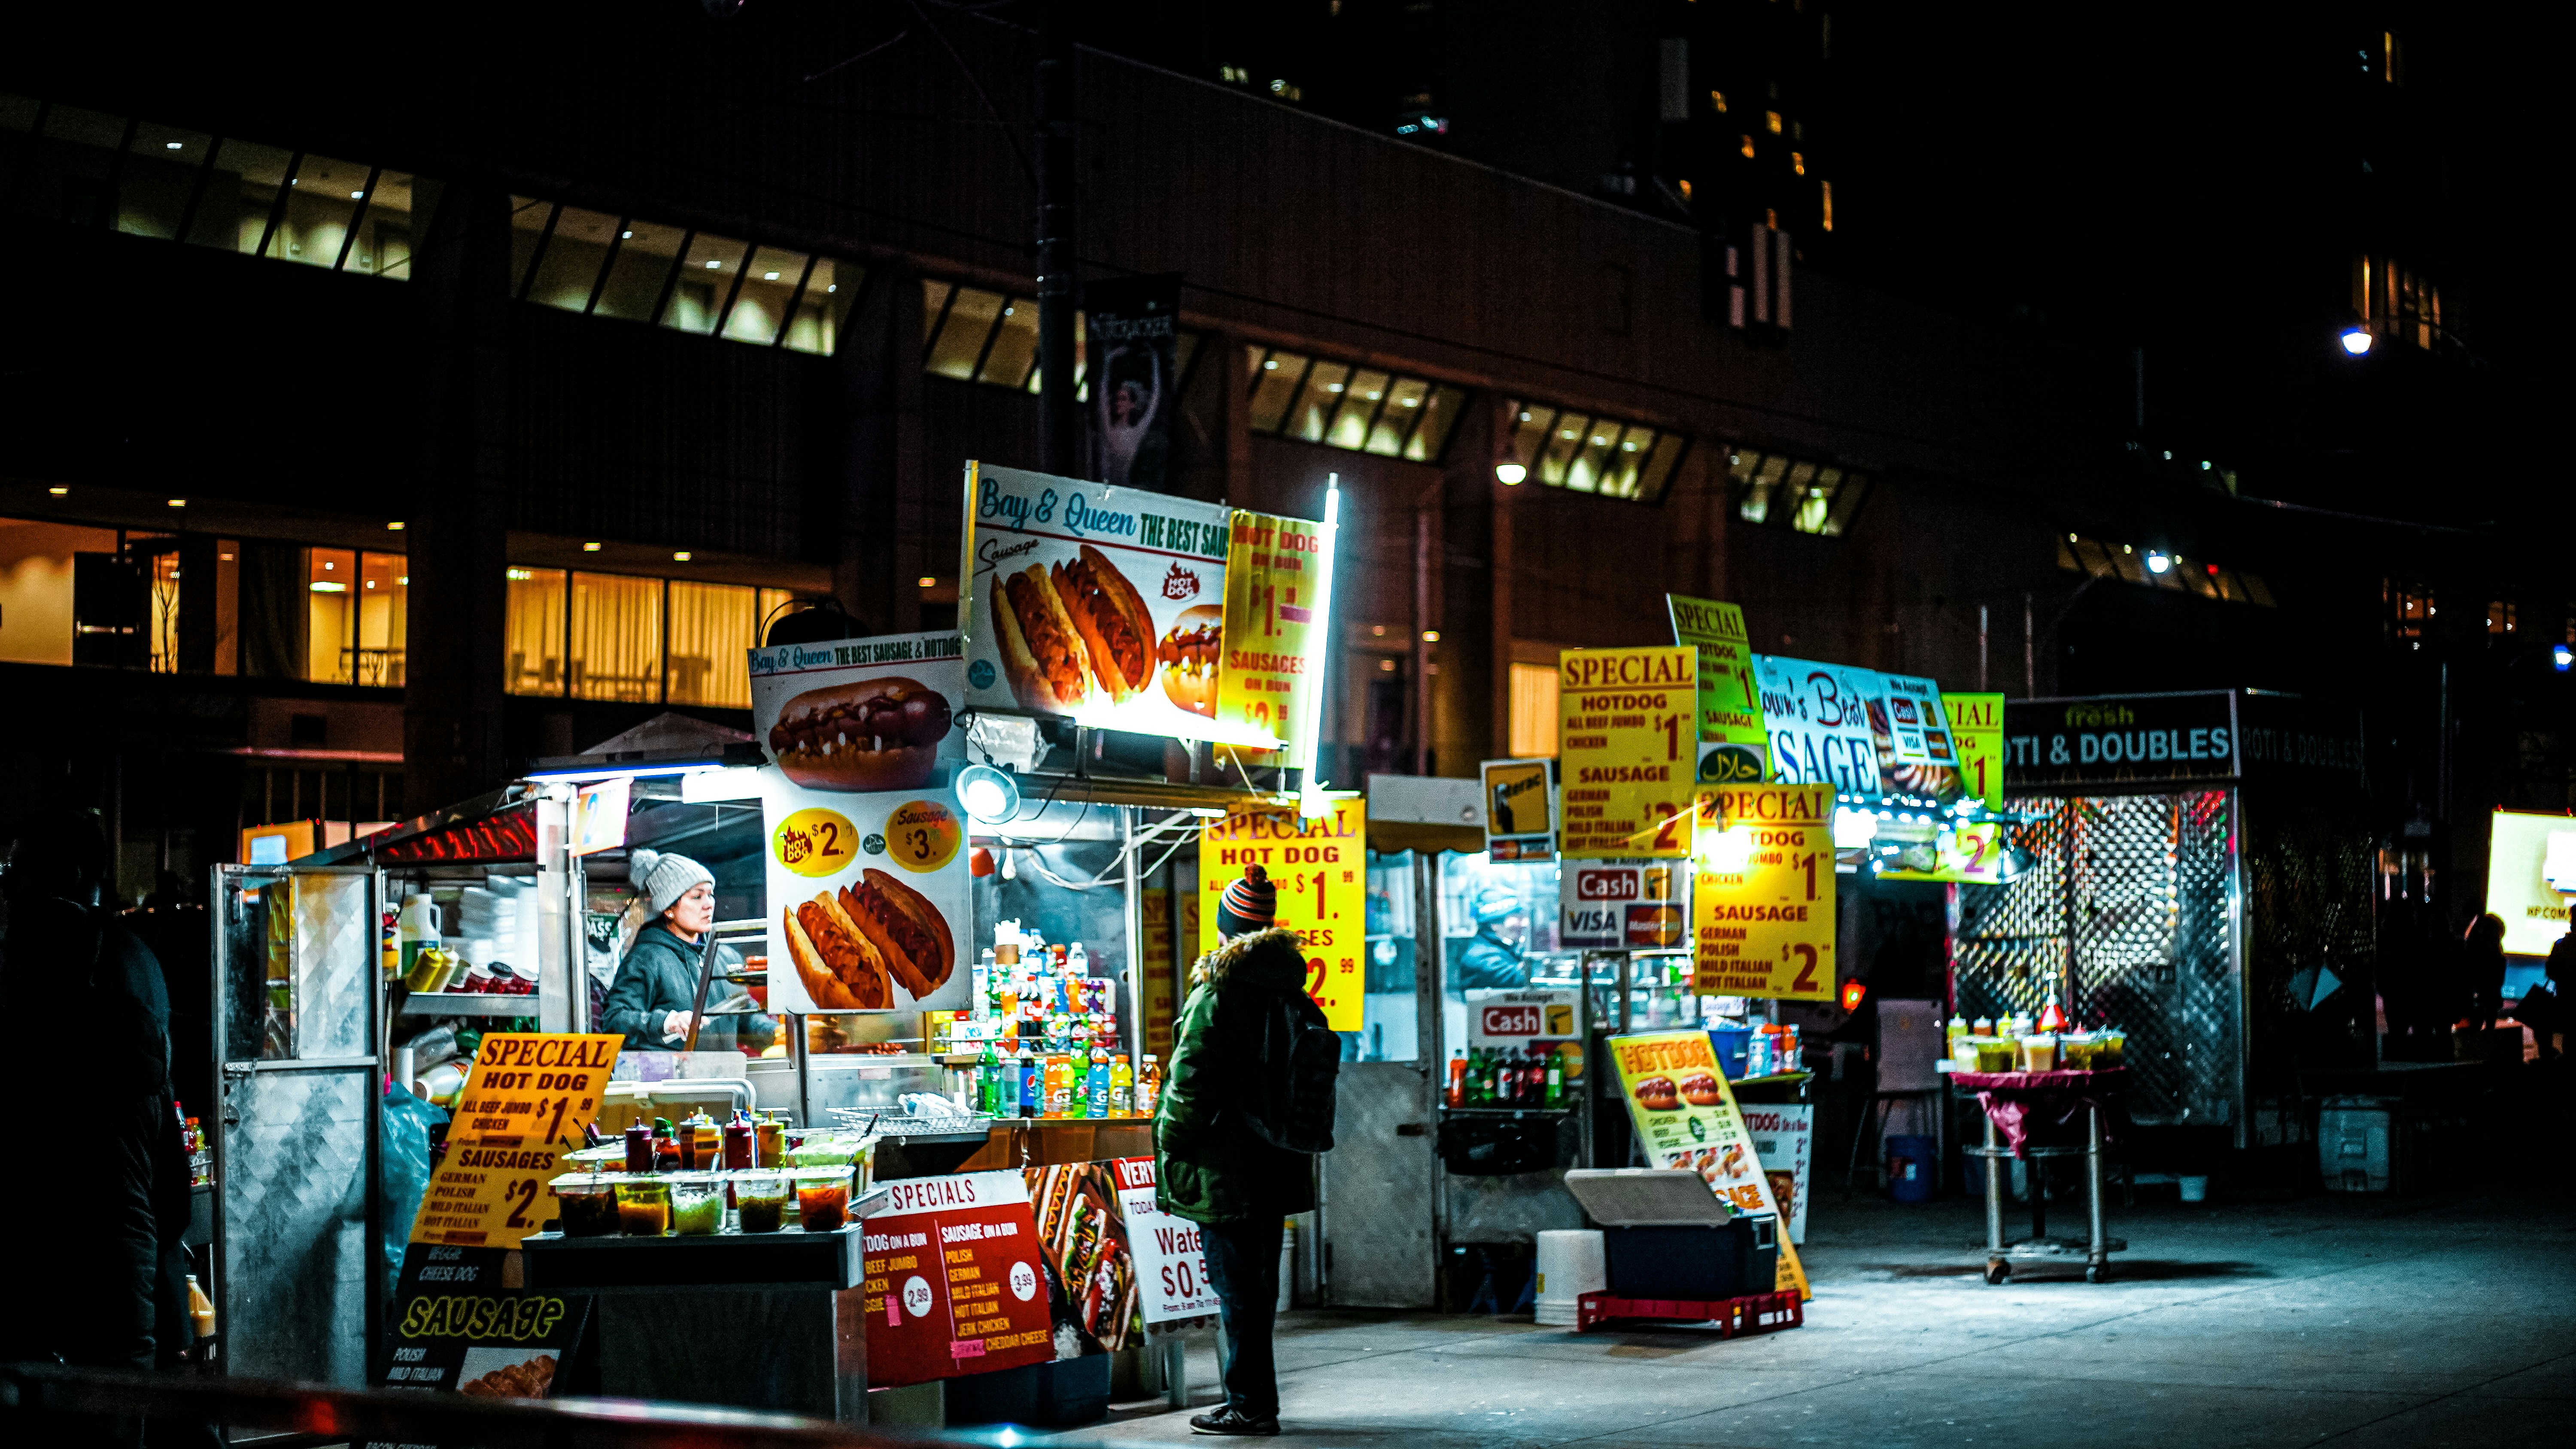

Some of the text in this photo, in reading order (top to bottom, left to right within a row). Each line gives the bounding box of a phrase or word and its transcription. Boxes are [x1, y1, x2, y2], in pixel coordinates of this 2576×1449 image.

[980, 477, 1229, 558] Bay & Queen THE BEST SAU
[1235, 526, 1318, 553] HOT DOG
[974, 538, 1039, 576] Sausage
[1167, 586, 1194, 596] DOG
[1169, 578, 1192, 587] HOT
[1675, 603, 1741, 637] SPECIAL
[750, 637, 961, 675] Bay & Queen THE BEST SAUSAGE & HOTDOG
[1693, 642, 1738, 660] OTDOG
[1230, 650, 1305, 674] SAUSAGES
[1565, 654, 1692, 687] SPECIAL
[1582, 694, 1667, 711] HOTDOG
[1807, 672, 1865, 727] Best
[2066, 705, 2135, 728] fresh
[2049, 734, 2071, 766] &
[2080, 727, 2231, 764] DOUBLES
[1768, 730, 1877, 794] SAGE
[1580, 766, 1669, 783] SAUSAGE
[1701, 790, 1831, 820] SPECIAL
[787, 838, 806, 850] HOT
[1751, 831, 1805, 847] TDOG
[787, 848, 809, 861] DOG
[1221, 846, 1339, 865] HOT DOG
[1581, 873, 1635, 896] Cash
[1701, 873, 1743, 885] CHICKEN
[1569, 910, 1617, 931] VISA
[1714, 904, 1808, 922] SAUSAGE
[1701, 927, 1747, 940] GERMAN
[1701, 944, 1740, 957] POLISH
[1700, 960, 1773, 973] MILD ITALIAN
[1700, 976, 1767, 990] HOT ITALIAN
[1486, 1009, 1537, 1032] Cash
[480, 1039, 610, 1068] SPECIAL
[1620, 1040, 1714, 1075] HOTDOG
[482, 1072, 590, 1091] HOT DOG
[461, 1100, 532, 1115] ALL BEEF JUMBO
[471, 1118, 510, 1130] CHICKEN
[458, 1149, 556, 1170] SAUSAGES
[440, 1172, 486, 1184] GERMAN
[1119, 1160, 1156, 1186] VERY
[434, 1186, 476, 1198] POLISH
[892, 1179, 975, 1210] SPECIALS
[430, 1202, 491, 1214] MILD ITALIAN
[423, 1216, 480, 1228] HOT ITALIAN
[890, 1235, 903, 1249] ON
[903, 1234, 910, 1248] A
[909, 1233, 927, 1247] BUN
[942, 1222, 1018, 1243] SAUSAGE ON A BUN
[1154, 1227, 1203, 1255] Wate
[865, 1255, 918, 1274] BEEF JUMBO
[945, 1249, 974, 1264] POLISH
[419, 1266, 480, 1281] CHEESE DOG
[948, 1266, 981, 1282] GERMAN
[1161, 1259, 1209, 1298] $0.5
[951, 1282, 1000, 1300] MILD ITALIAN
[954, 1300, 999, 1319] HOT ITALIAN
[957, 1317, 1011, 1337] JERK CHICKEN
[986, 1334, 1021, 1351] CHEDDAR
[1020, 1329, 1049, 1346] CHEESE
[393, 1348, 427, 1361] POLISH
[386, 1367, 445, 1381] MILD ITALIAN
